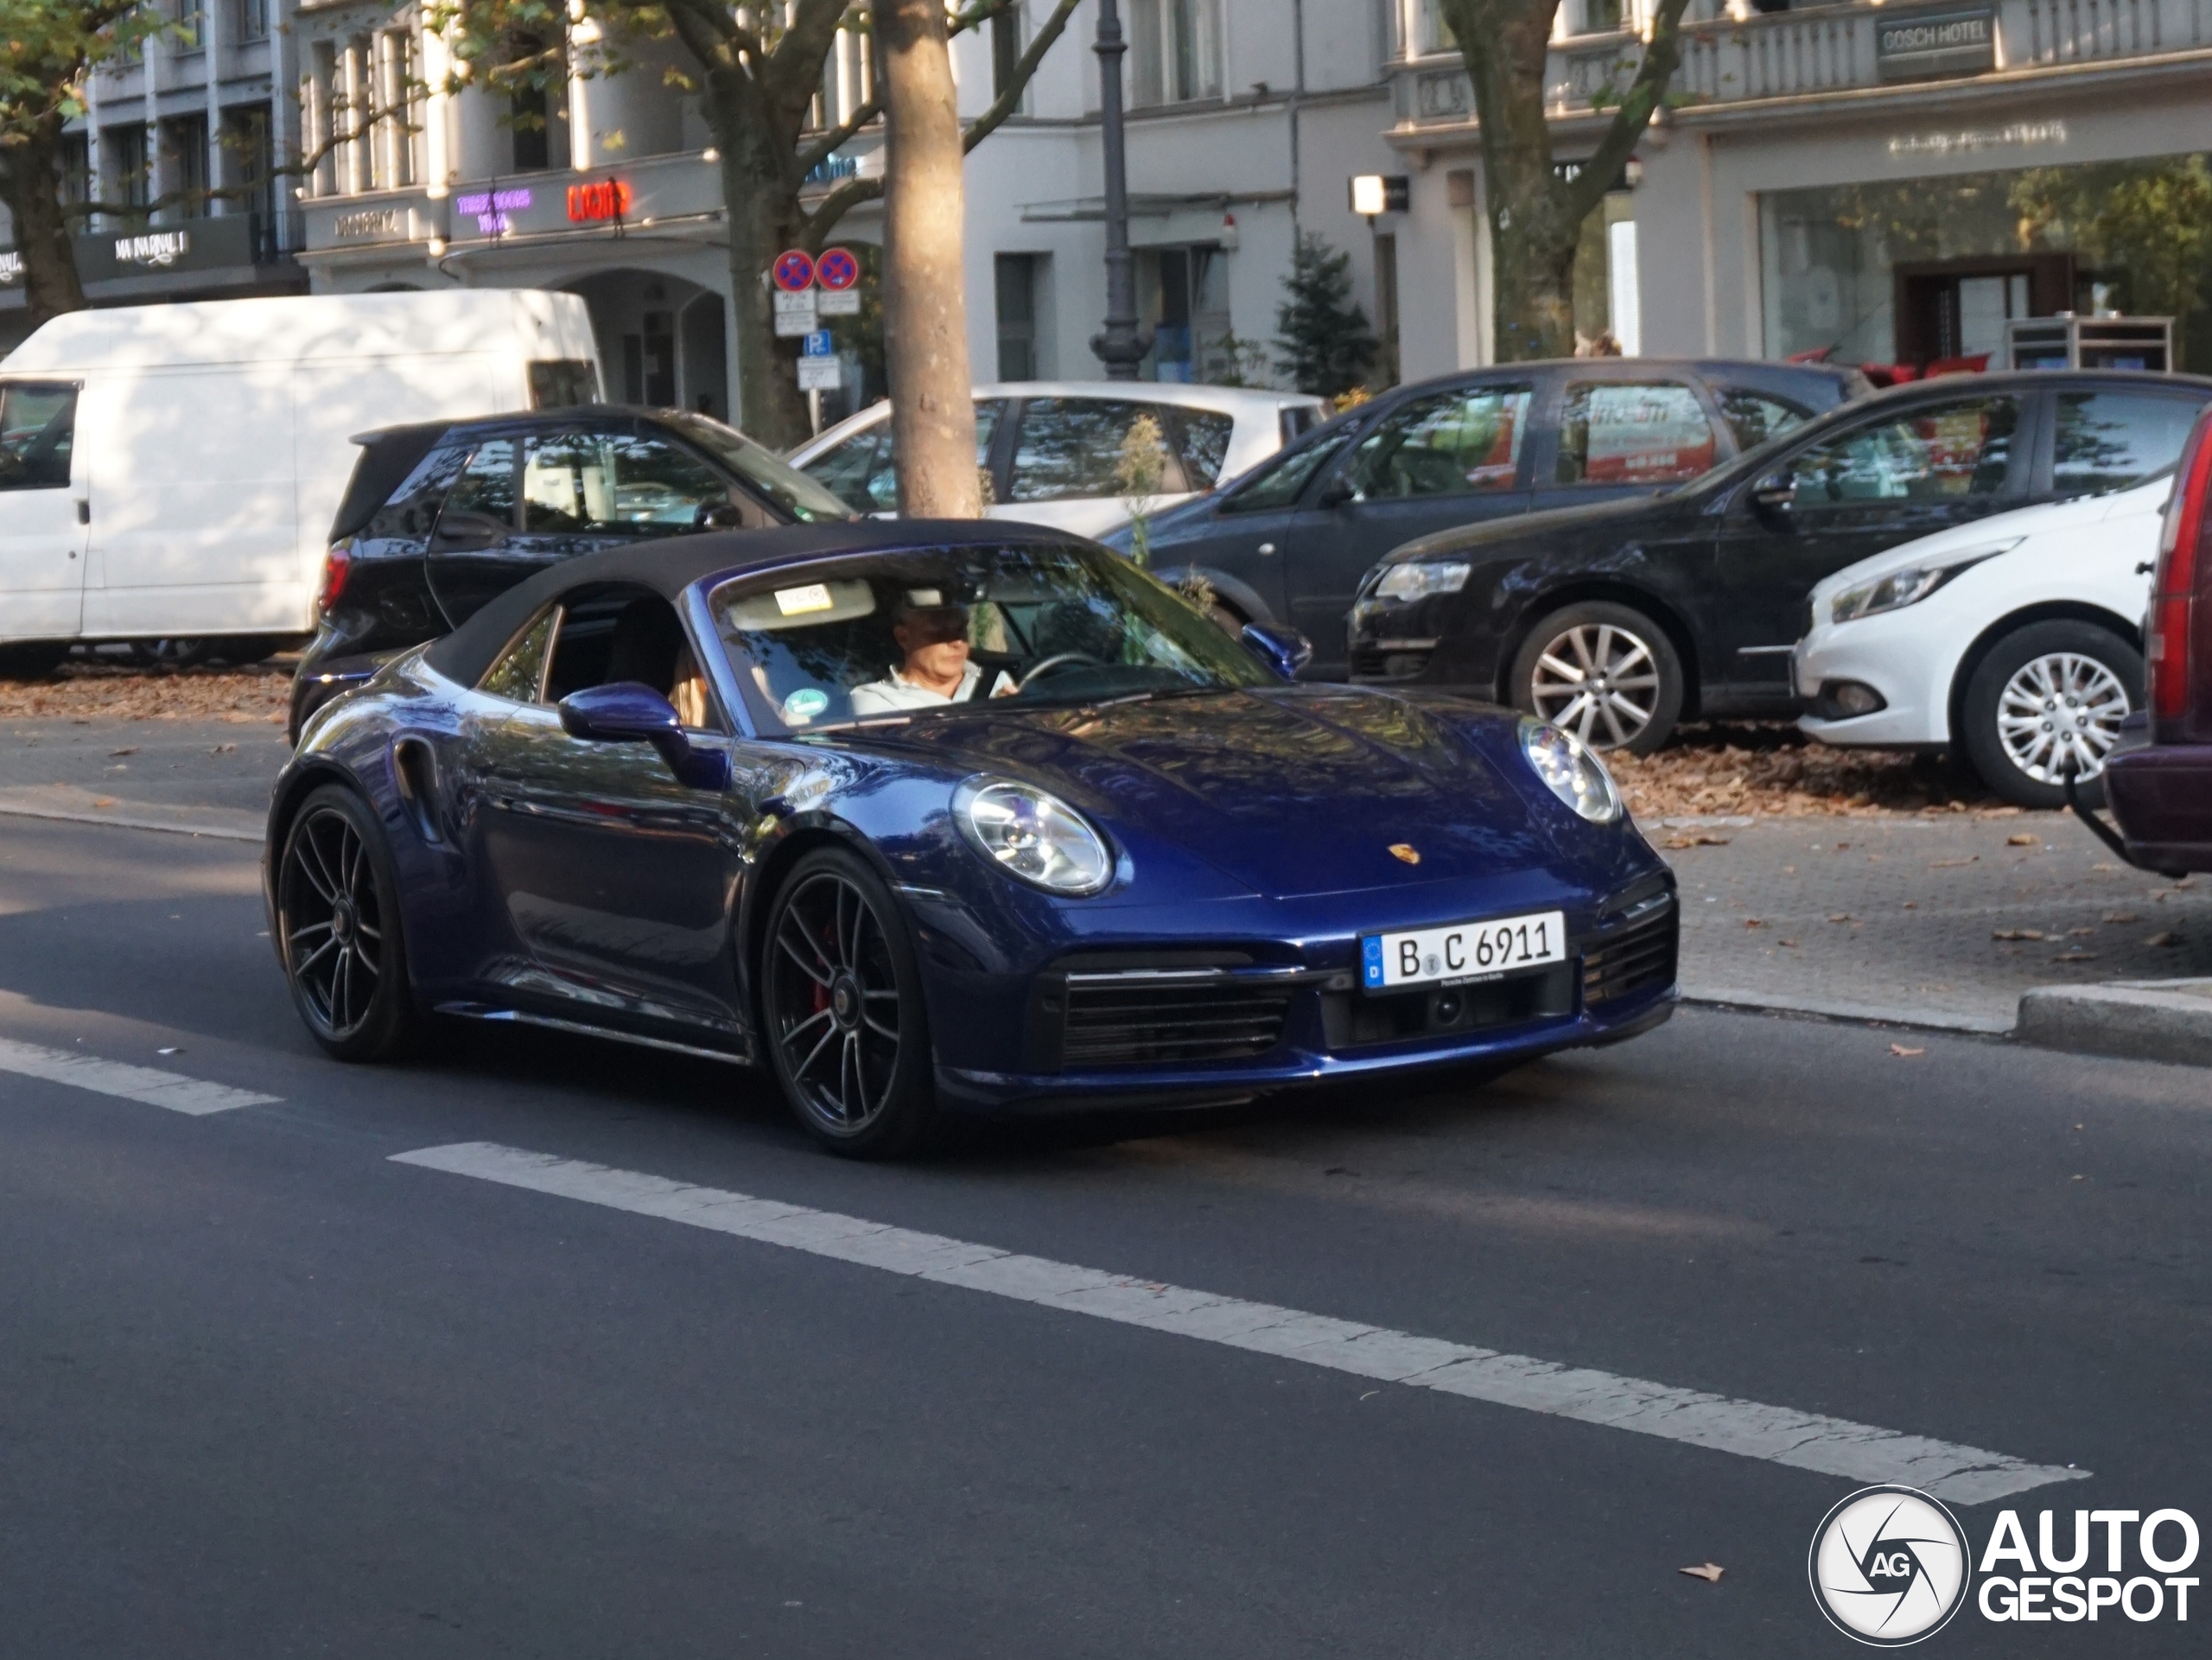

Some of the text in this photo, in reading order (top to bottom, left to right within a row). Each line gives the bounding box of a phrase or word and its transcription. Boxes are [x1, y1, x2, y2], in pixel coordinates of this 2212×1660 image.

[1938, 21, 1987, 43] HOTEL
[1399, 921, 1551, 977] B C 6911
[1370, 966, 1379, 978] D
